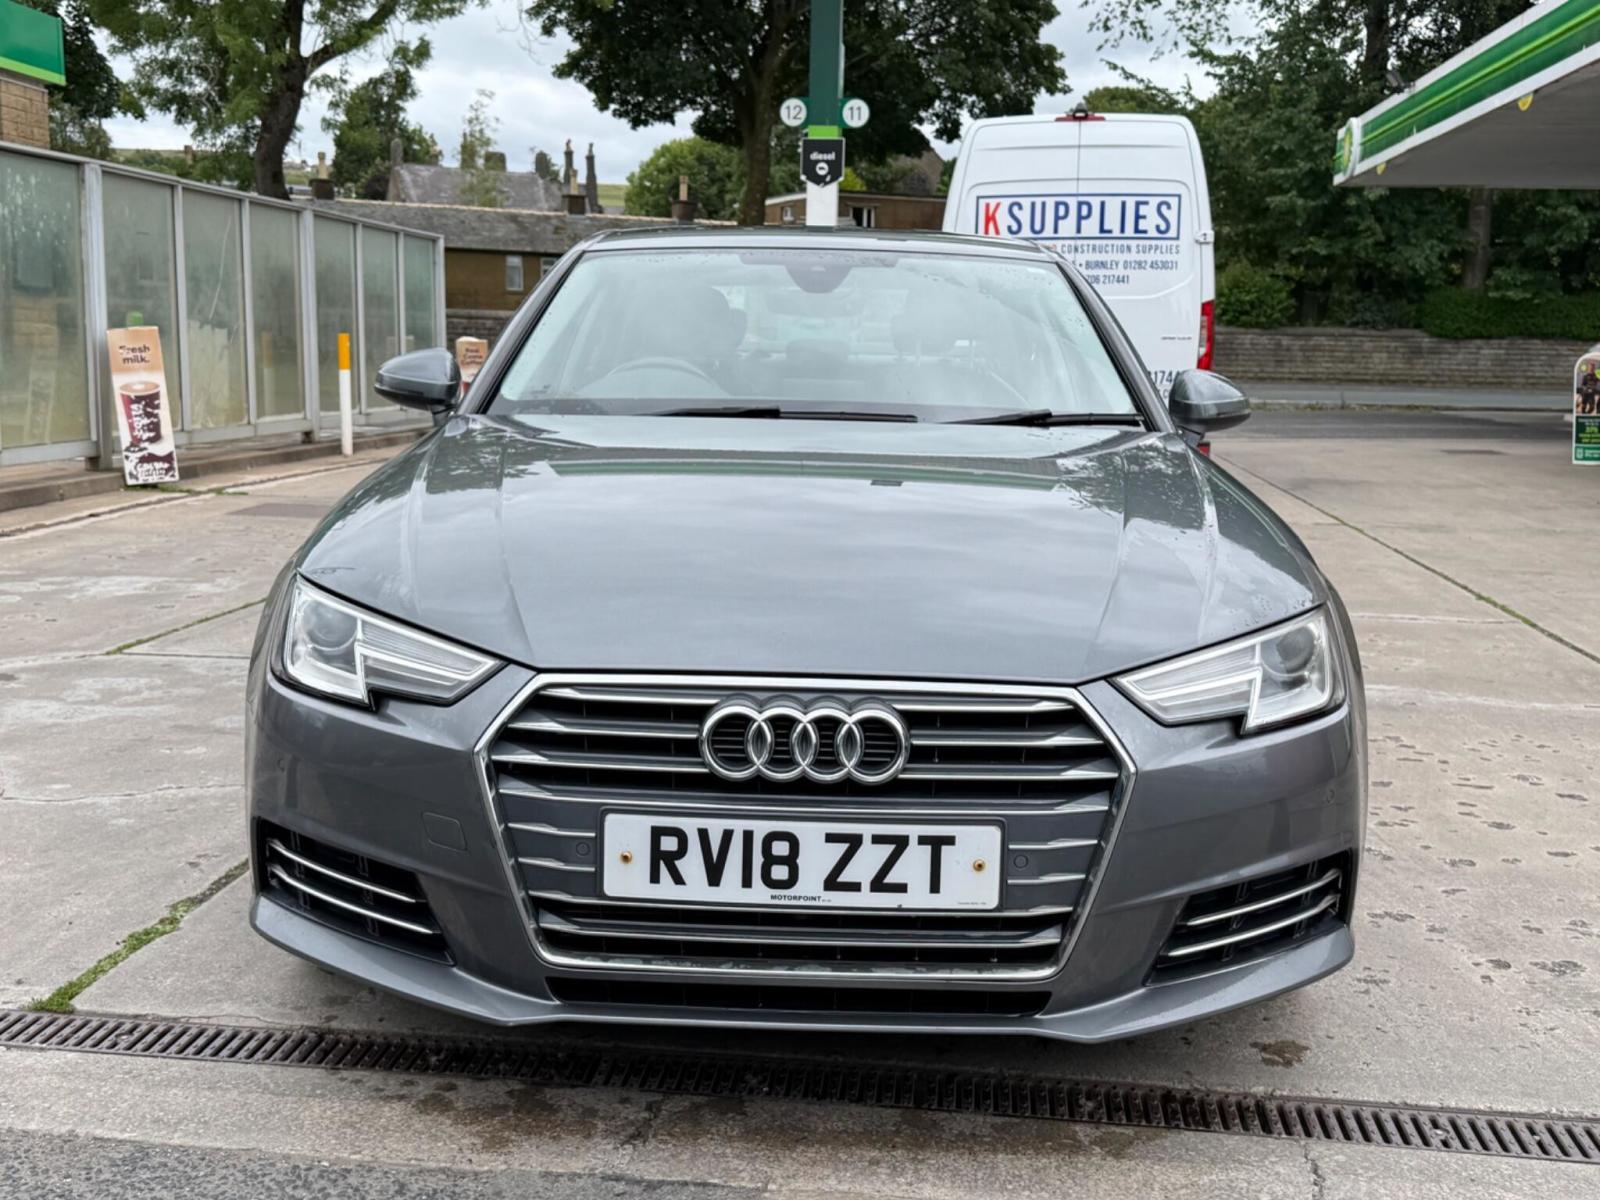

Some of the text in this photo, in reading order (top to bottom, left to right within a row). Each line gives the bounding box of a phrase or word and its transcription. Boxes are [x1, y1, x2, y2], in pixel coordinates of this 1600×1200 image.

[785, 105, 802, 120] 12
[848, 106, 862, 121] 11
[809, 151, 836, 160] diesel
[1061, 244, 1132, 254] CONSTRUCTION
[1135, 244, 1180, 255] SUPPLIES
[1085, 260, 1119, 270] BURNLEY
[1123, 260, 1147, 270] 01282
[1102, 275, 1130, 284] 217441
[649, 825, 956, 894] RV18 ZZT
[770, 894, 822, 902] MOTORPOINT
